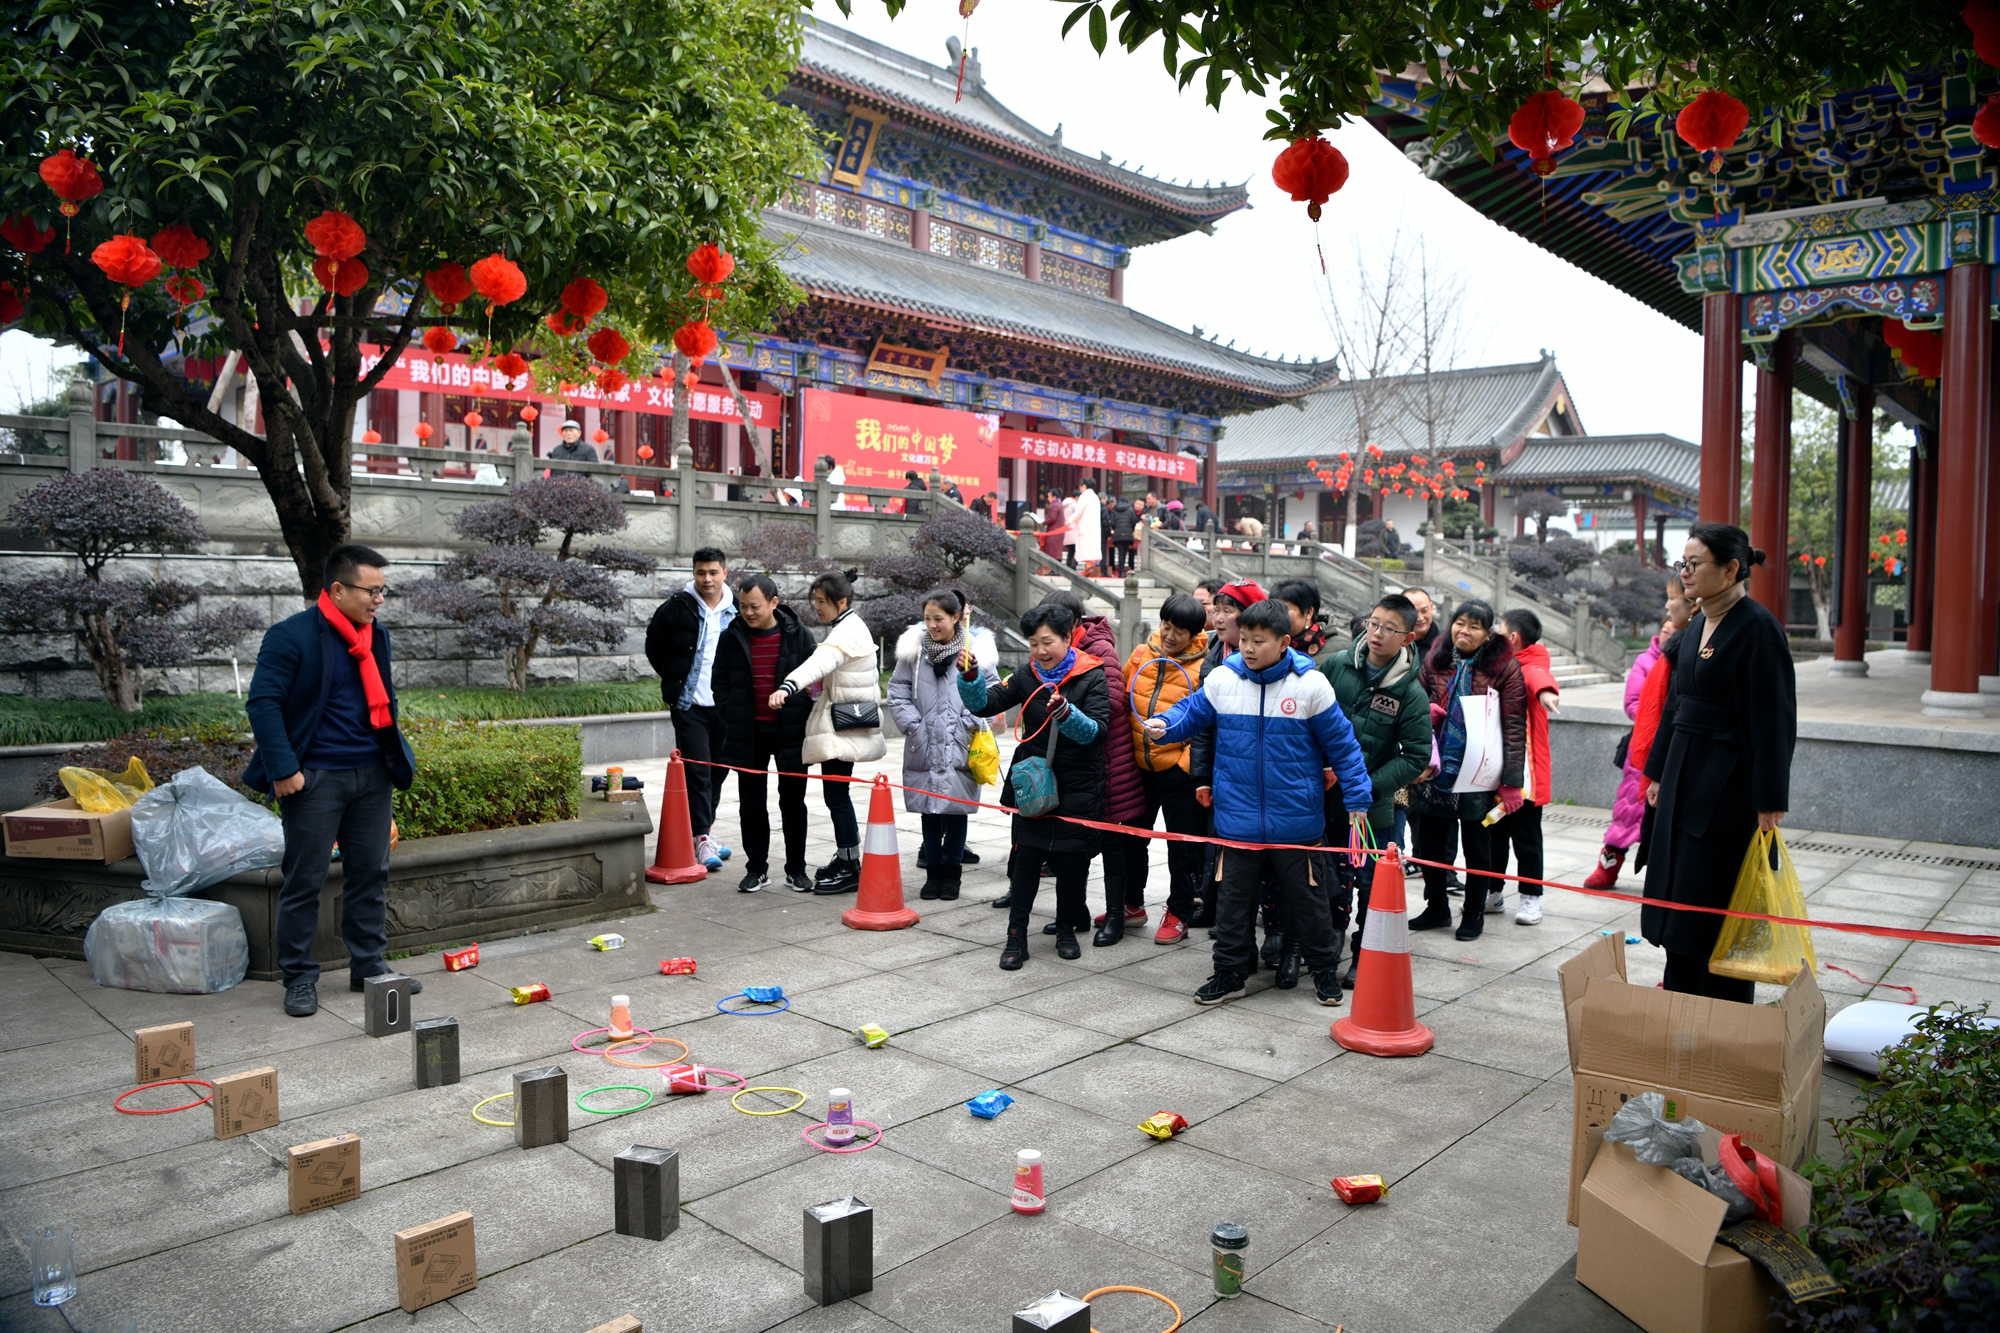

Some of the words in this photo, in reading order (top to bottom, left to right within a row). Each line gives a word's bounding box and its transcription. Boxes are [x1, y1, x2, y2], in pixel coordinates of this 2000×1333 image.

[855, 418, 958, 464] 我们的中国梦
[901, 453, 940, 465] 文化进万家
[1020, 437, 1107, 464] 不忘初心跟党走
[1115, 450, 1186, 476] 牢记使命加油干
